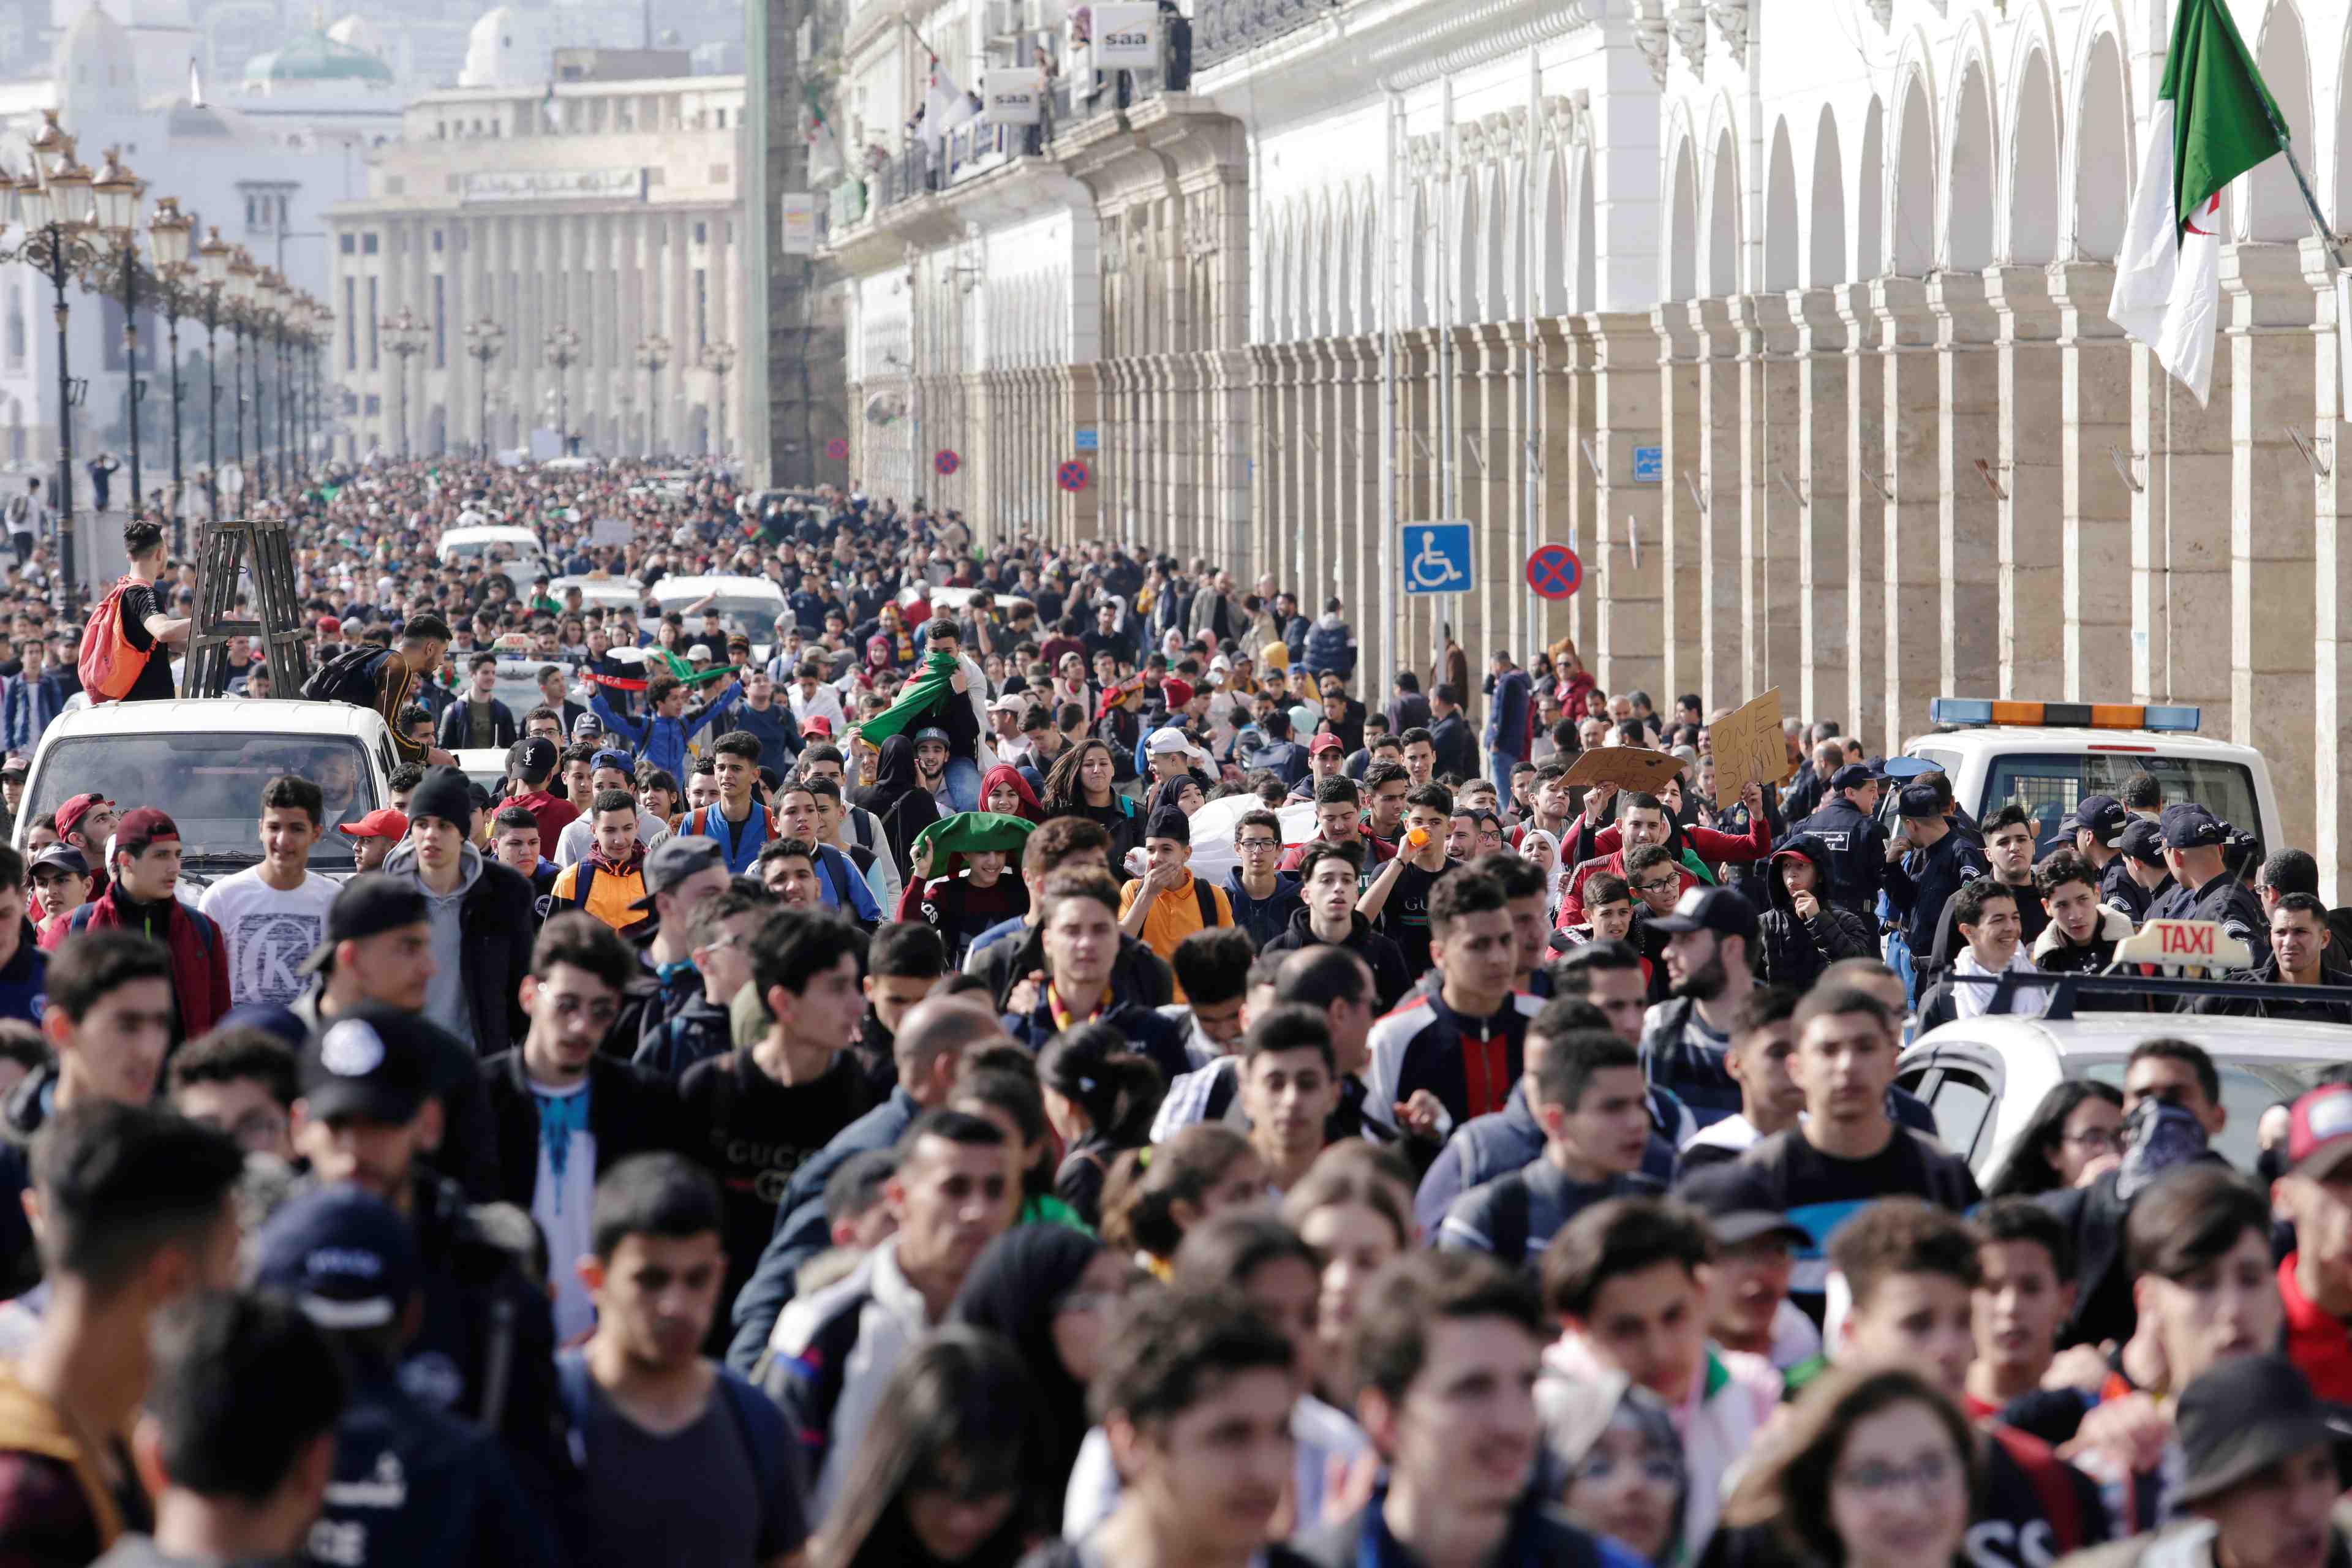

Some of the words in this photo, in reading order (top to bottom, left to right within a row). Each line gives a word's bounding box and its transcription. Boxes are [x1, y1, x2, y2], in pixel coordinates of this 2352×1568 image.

[1106, 34, 1147, 45] saa
[995, 95, 1030, 104] saa
[1717, 701, 1774, 753] ONE
[2157, 924, 2215, 954] TAXI
